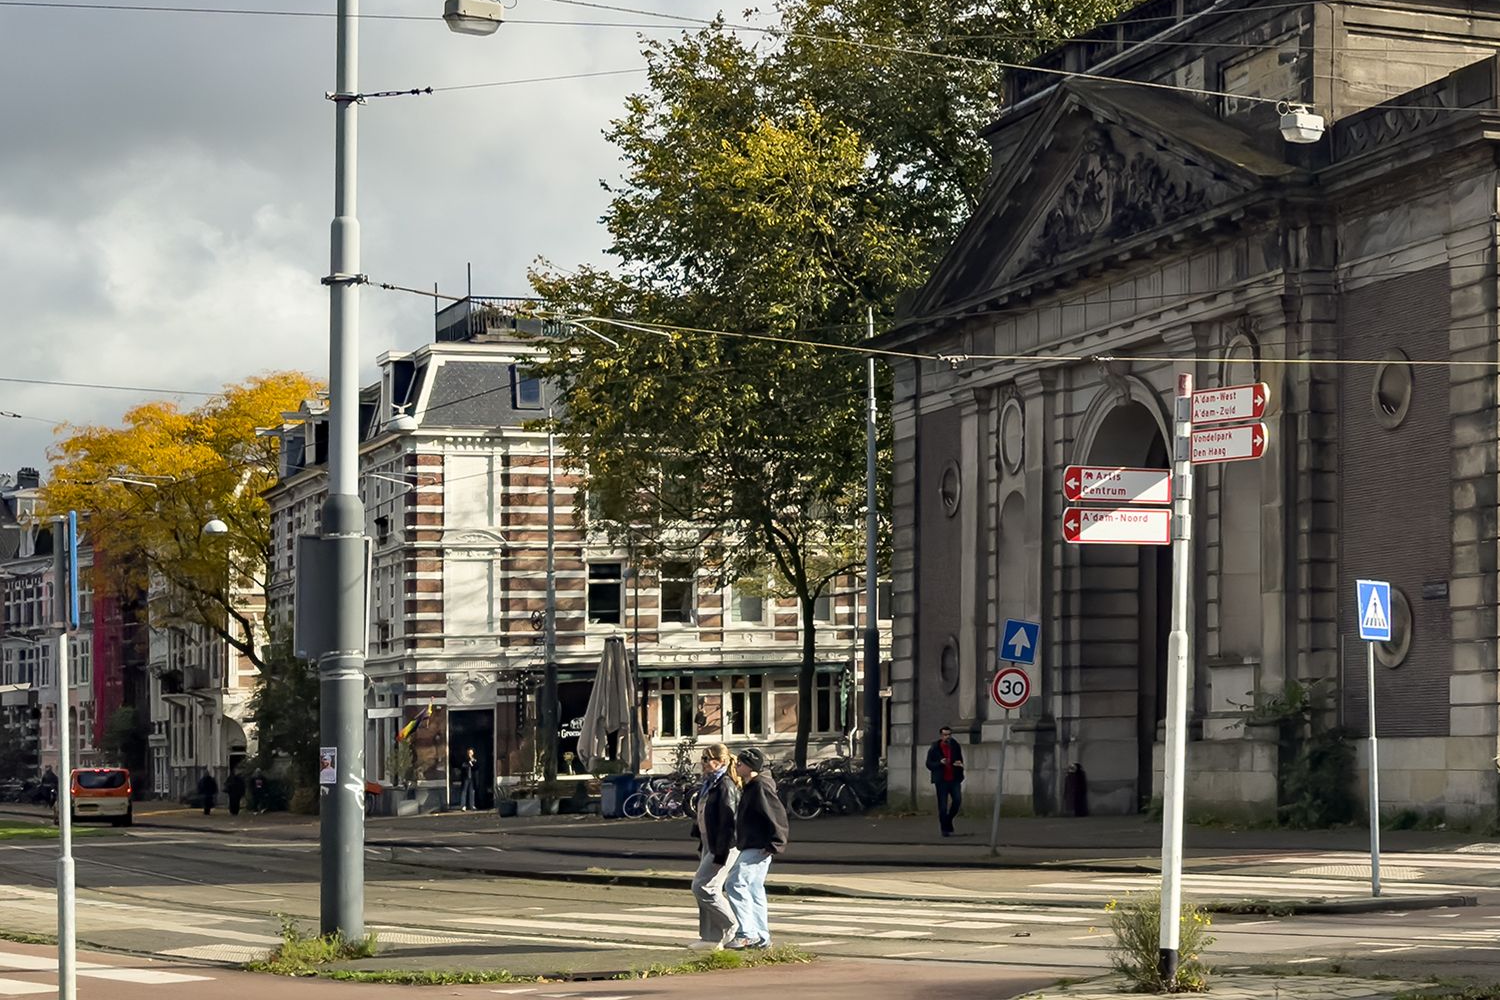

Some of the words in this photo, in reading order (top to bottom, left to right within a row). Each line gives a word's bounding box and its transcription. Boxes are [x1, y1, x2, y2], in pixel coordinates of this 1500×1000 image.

[1193, 431, 1232, 443] Vondelpark
[1193, 448, 1207, 457] Den
[1208, 447, 1226, 456] Haag
[1082, 485, 1127, 496] Centrum
[1000, 680, 1024, 696] 30
